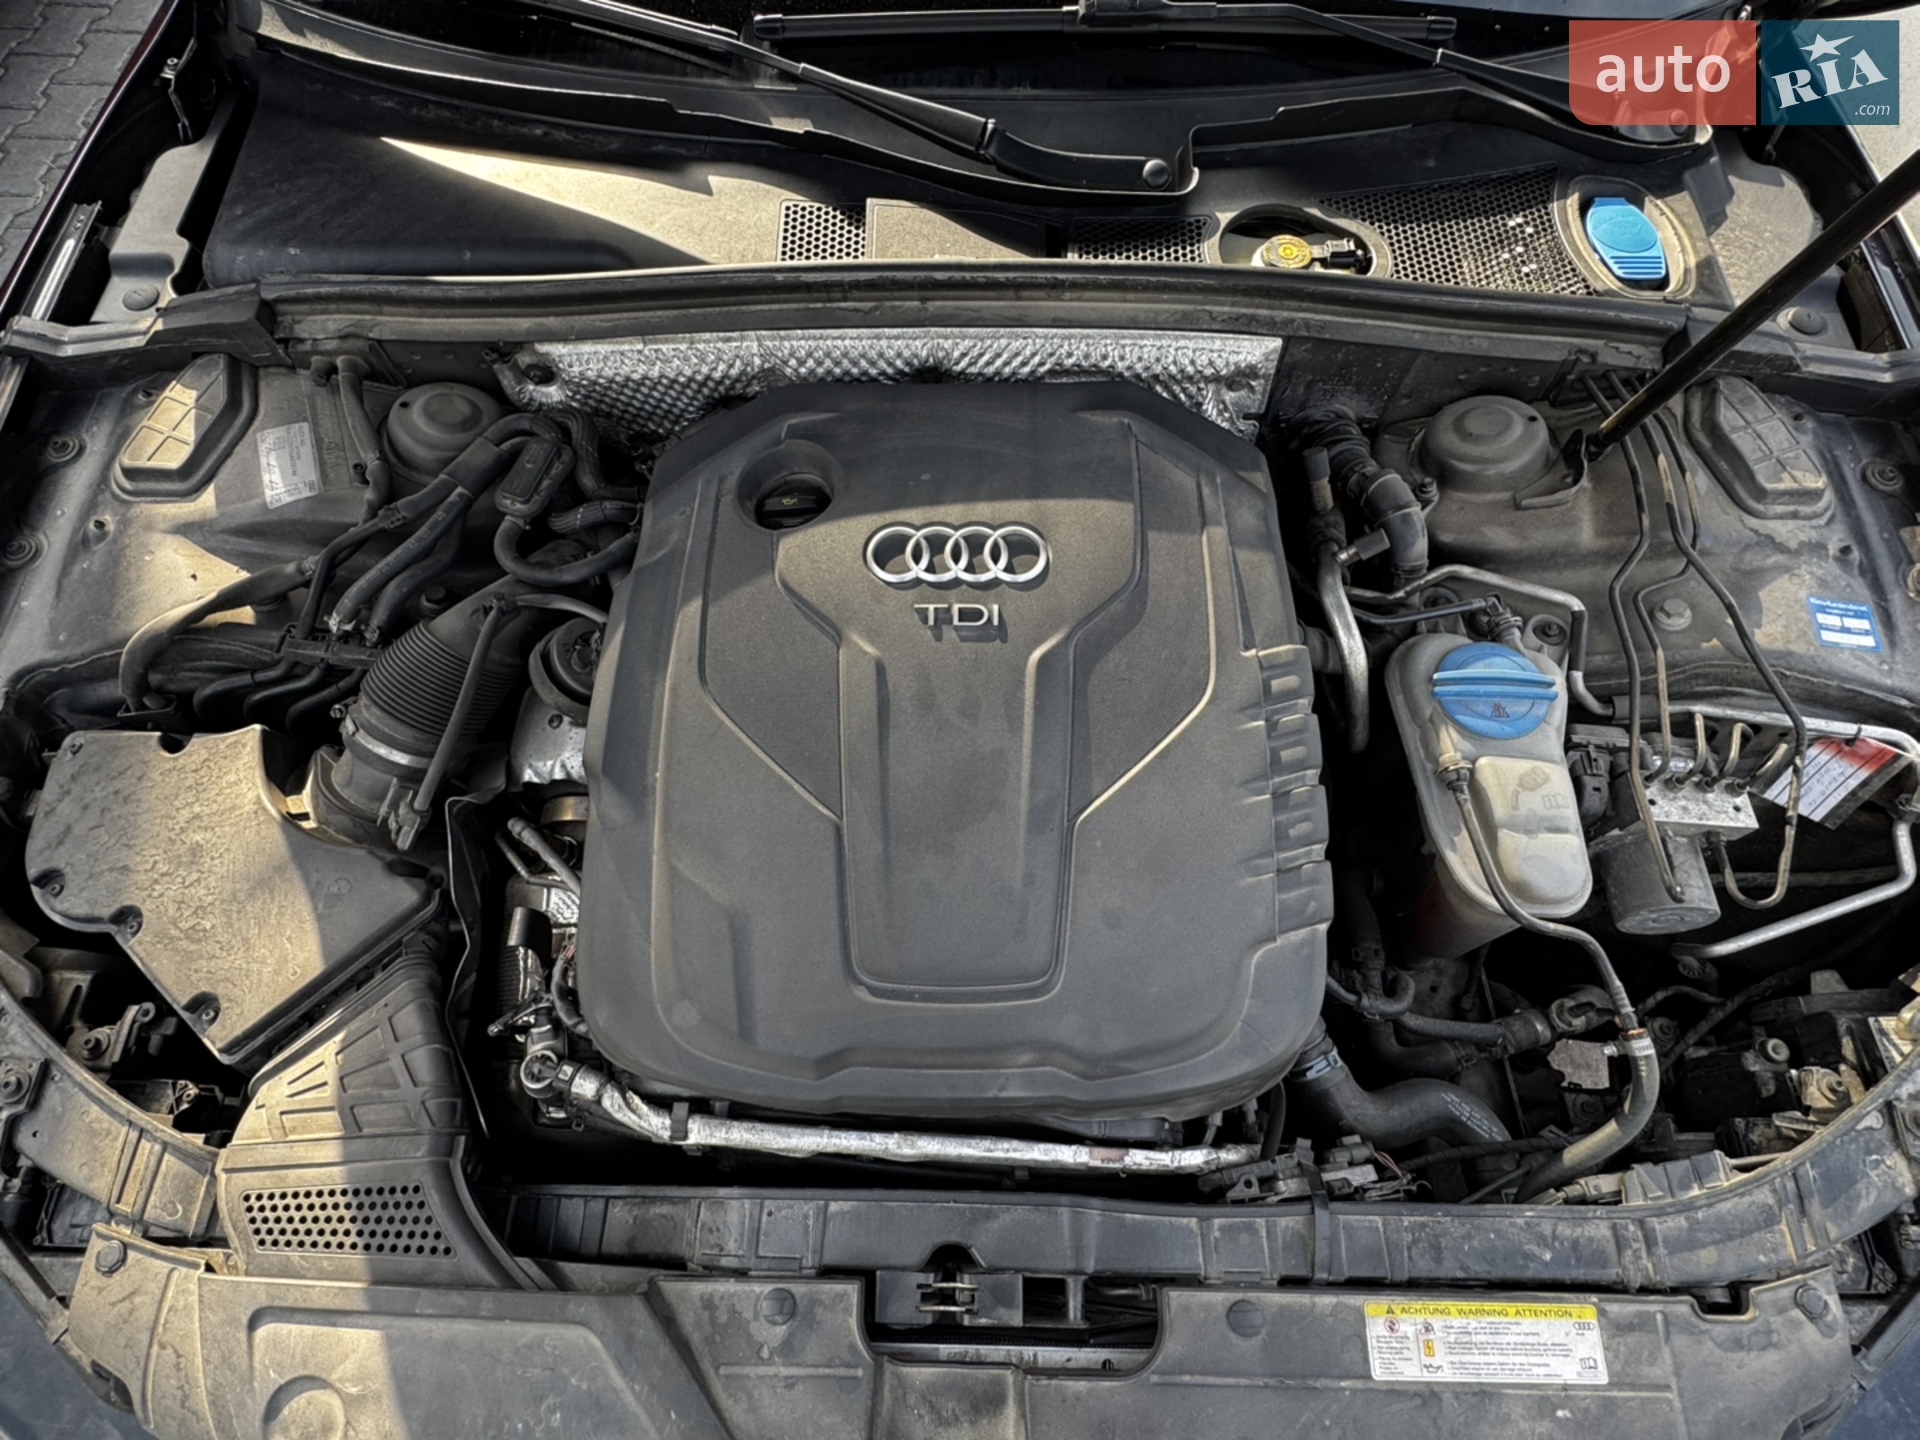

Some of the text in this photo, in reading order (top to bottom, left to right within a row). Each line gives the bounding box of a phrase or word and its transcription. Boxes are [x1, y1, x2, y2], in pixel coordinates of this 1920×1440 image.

[913, 603, 999, 626] TDI
[1400, 1306, 1573, 1319] ACHTUNG WARNING ATTENTION
